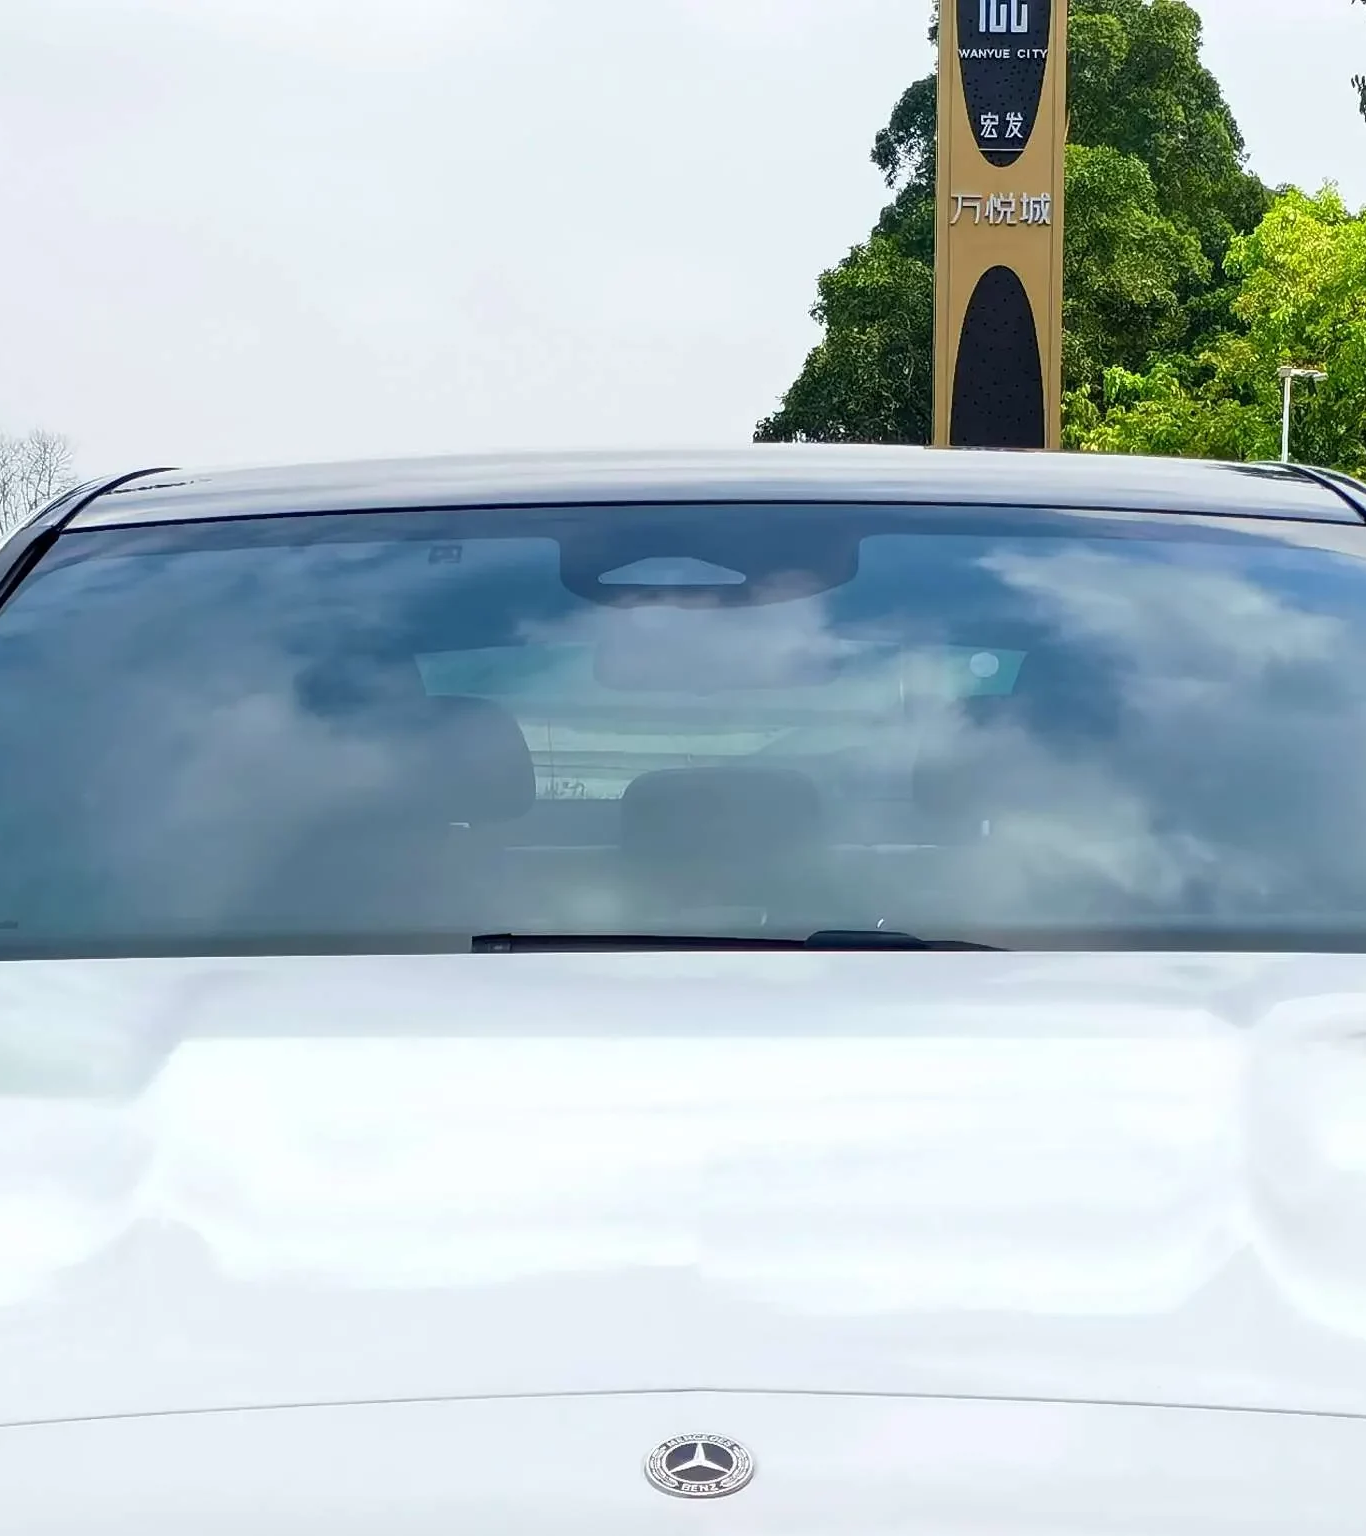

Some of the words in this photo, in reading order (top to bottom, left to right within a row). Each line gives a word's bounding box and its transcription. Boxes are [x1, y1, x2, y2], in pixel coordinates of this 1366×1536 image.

[958, 48, 1011, 59] WANYUE
[1017, 48, 1048, 59] CITY
[980, 111, 1024, 139] 宏发
[949, 191, 1052, 226] 万悦城
[681, 1483, 719, 1492] BENZ
